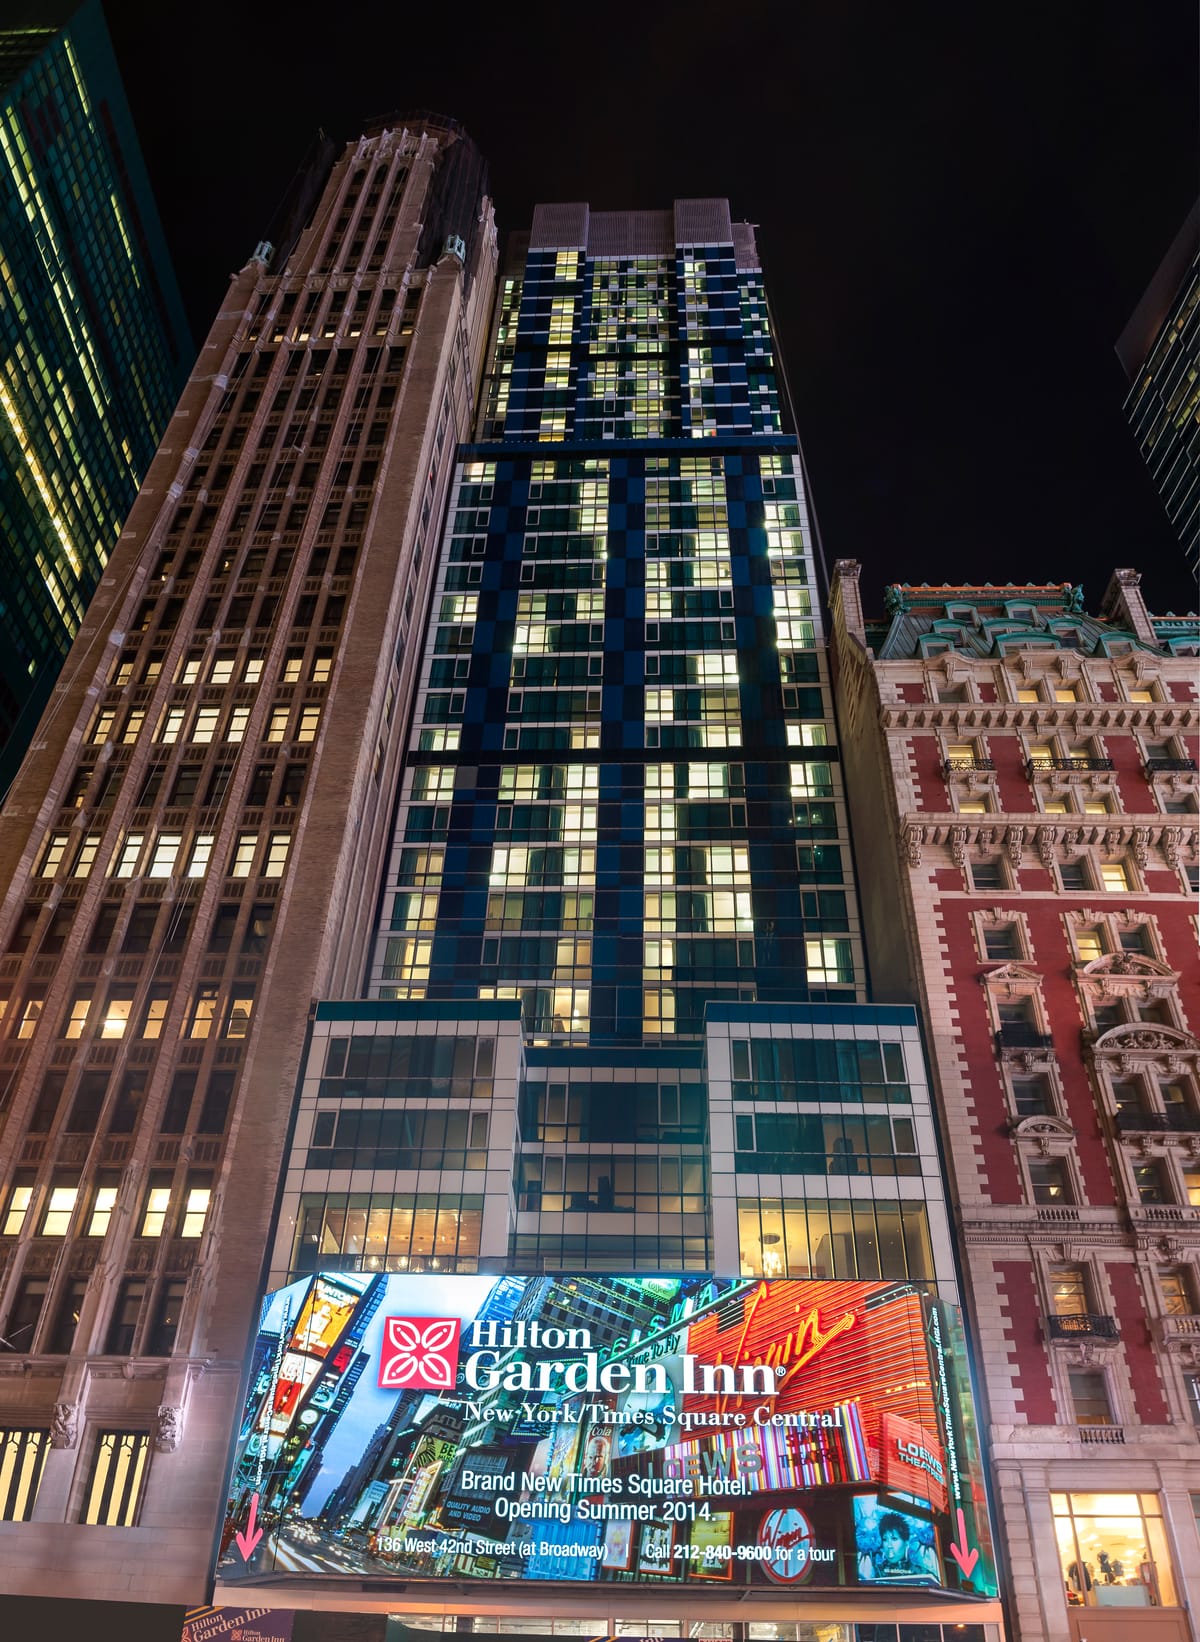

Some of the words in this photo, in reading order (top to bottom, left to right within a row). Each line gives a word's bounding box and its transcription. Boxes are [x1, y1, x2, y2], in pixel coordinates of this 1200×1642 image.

[468, 1319, 594, 1350] Hilton
[651, 1341, 664, 1360] To
[664, 1333, 681, 1355] Fly
[465, 1349, 669, 1395] Garden
[462, 1401, 515, 1423] New
[519, 1401, 655, 1425] York/Times
[662, 1404, 746, 1432] Square
[753, 1405, 843, 1429] Central
[591, 1424, 612, 1437] Cola
[897, 1438, 944, 1474] LOEWS
[461, 1470, 515, 1491] Brand
[521, 1471, 562, 1492] New
[567, 1473, 623, 1493] Times
[627, 1474, 694, 1498] Square
[699, 1475, 752, 1496] Hotel.
[446, 1500, 471, 1512] QUALITY
[471, 1502, 491, 1515] AUDIO
[447, 1510, 462, 1519] AND
[462, 1512, 482, 1523] VIDEO
[494, 1496, 571, 1524] Opening
[577, 1498, 657, 1521] Summer
[662, 1501, 717, 1522] 2014.
[376, 1537, 402, 1553] 136
[404, 1537, 435, 1553] West
[439, 1539, 472, 1555] 42nd
[475, 1540, 516, 1556] Street
[518, 1541, 537, 1559] (at
[540, 1541, 609, 1560] Broadway)
[645, 1543, 670, 1559] Call
[673, 1544, 772, 1561] 212-840-9600
[775, 1545, 794, 1561] for
[797, 1548, 806, 1561] a
[808, 1546, 836, 1562] tour
[190, 1613, 224, 1632] Hilton
[193, 1616, 246, 1642] Garden
[244, 1608, 273, 1622] Inn
[242, 1629, 261, 1637] Hilton
